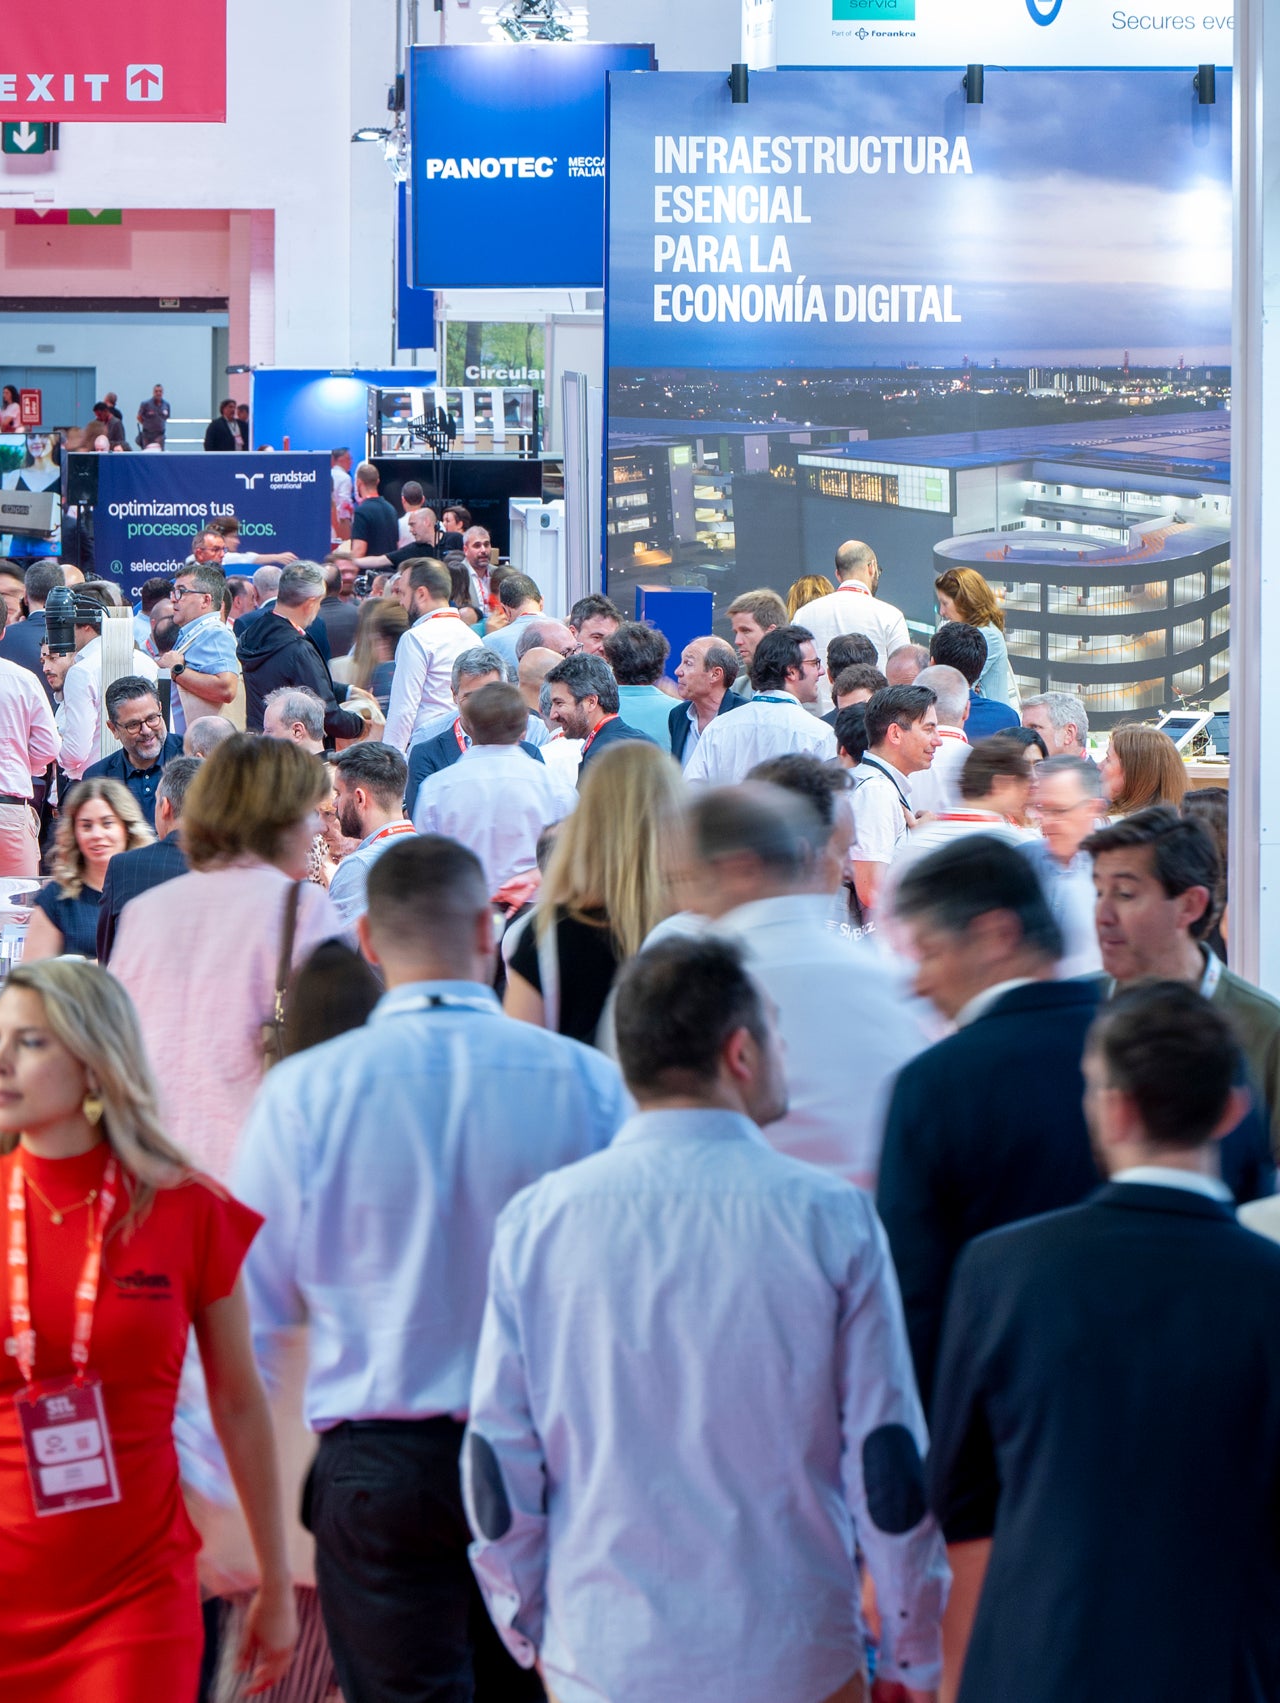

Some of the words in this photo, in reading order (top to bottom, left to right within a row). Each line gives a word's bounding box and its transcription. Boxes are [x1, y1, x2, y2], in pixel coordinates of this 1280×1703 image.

[1112, 10, 1196, 30] Secures
[871, 30, 916, 38] forankra
[654, 136, 974, 175] INFRAESTRUCTURA
[426, 157, 555, 180] PANOTEC
[568, 167, 605, 177] ITALIA
[654, 185, 812, 224] ESENCIAL
[654, 235, 743, 273] PARA
[749, 235, 792, 273] LA
[653, 275, 828, 323] ECONOMÍA
[834, 284, 962, 323] DIGITAL
[270, 470, 316, 482] randstad
[108, 500, 208, 519] optimizamos
[211, 501, 235, 516] tus
[128, 523, 198, 539] procesos
[201, 519, 277, 536] lticos.
[130, 559, 185, 572] selección
